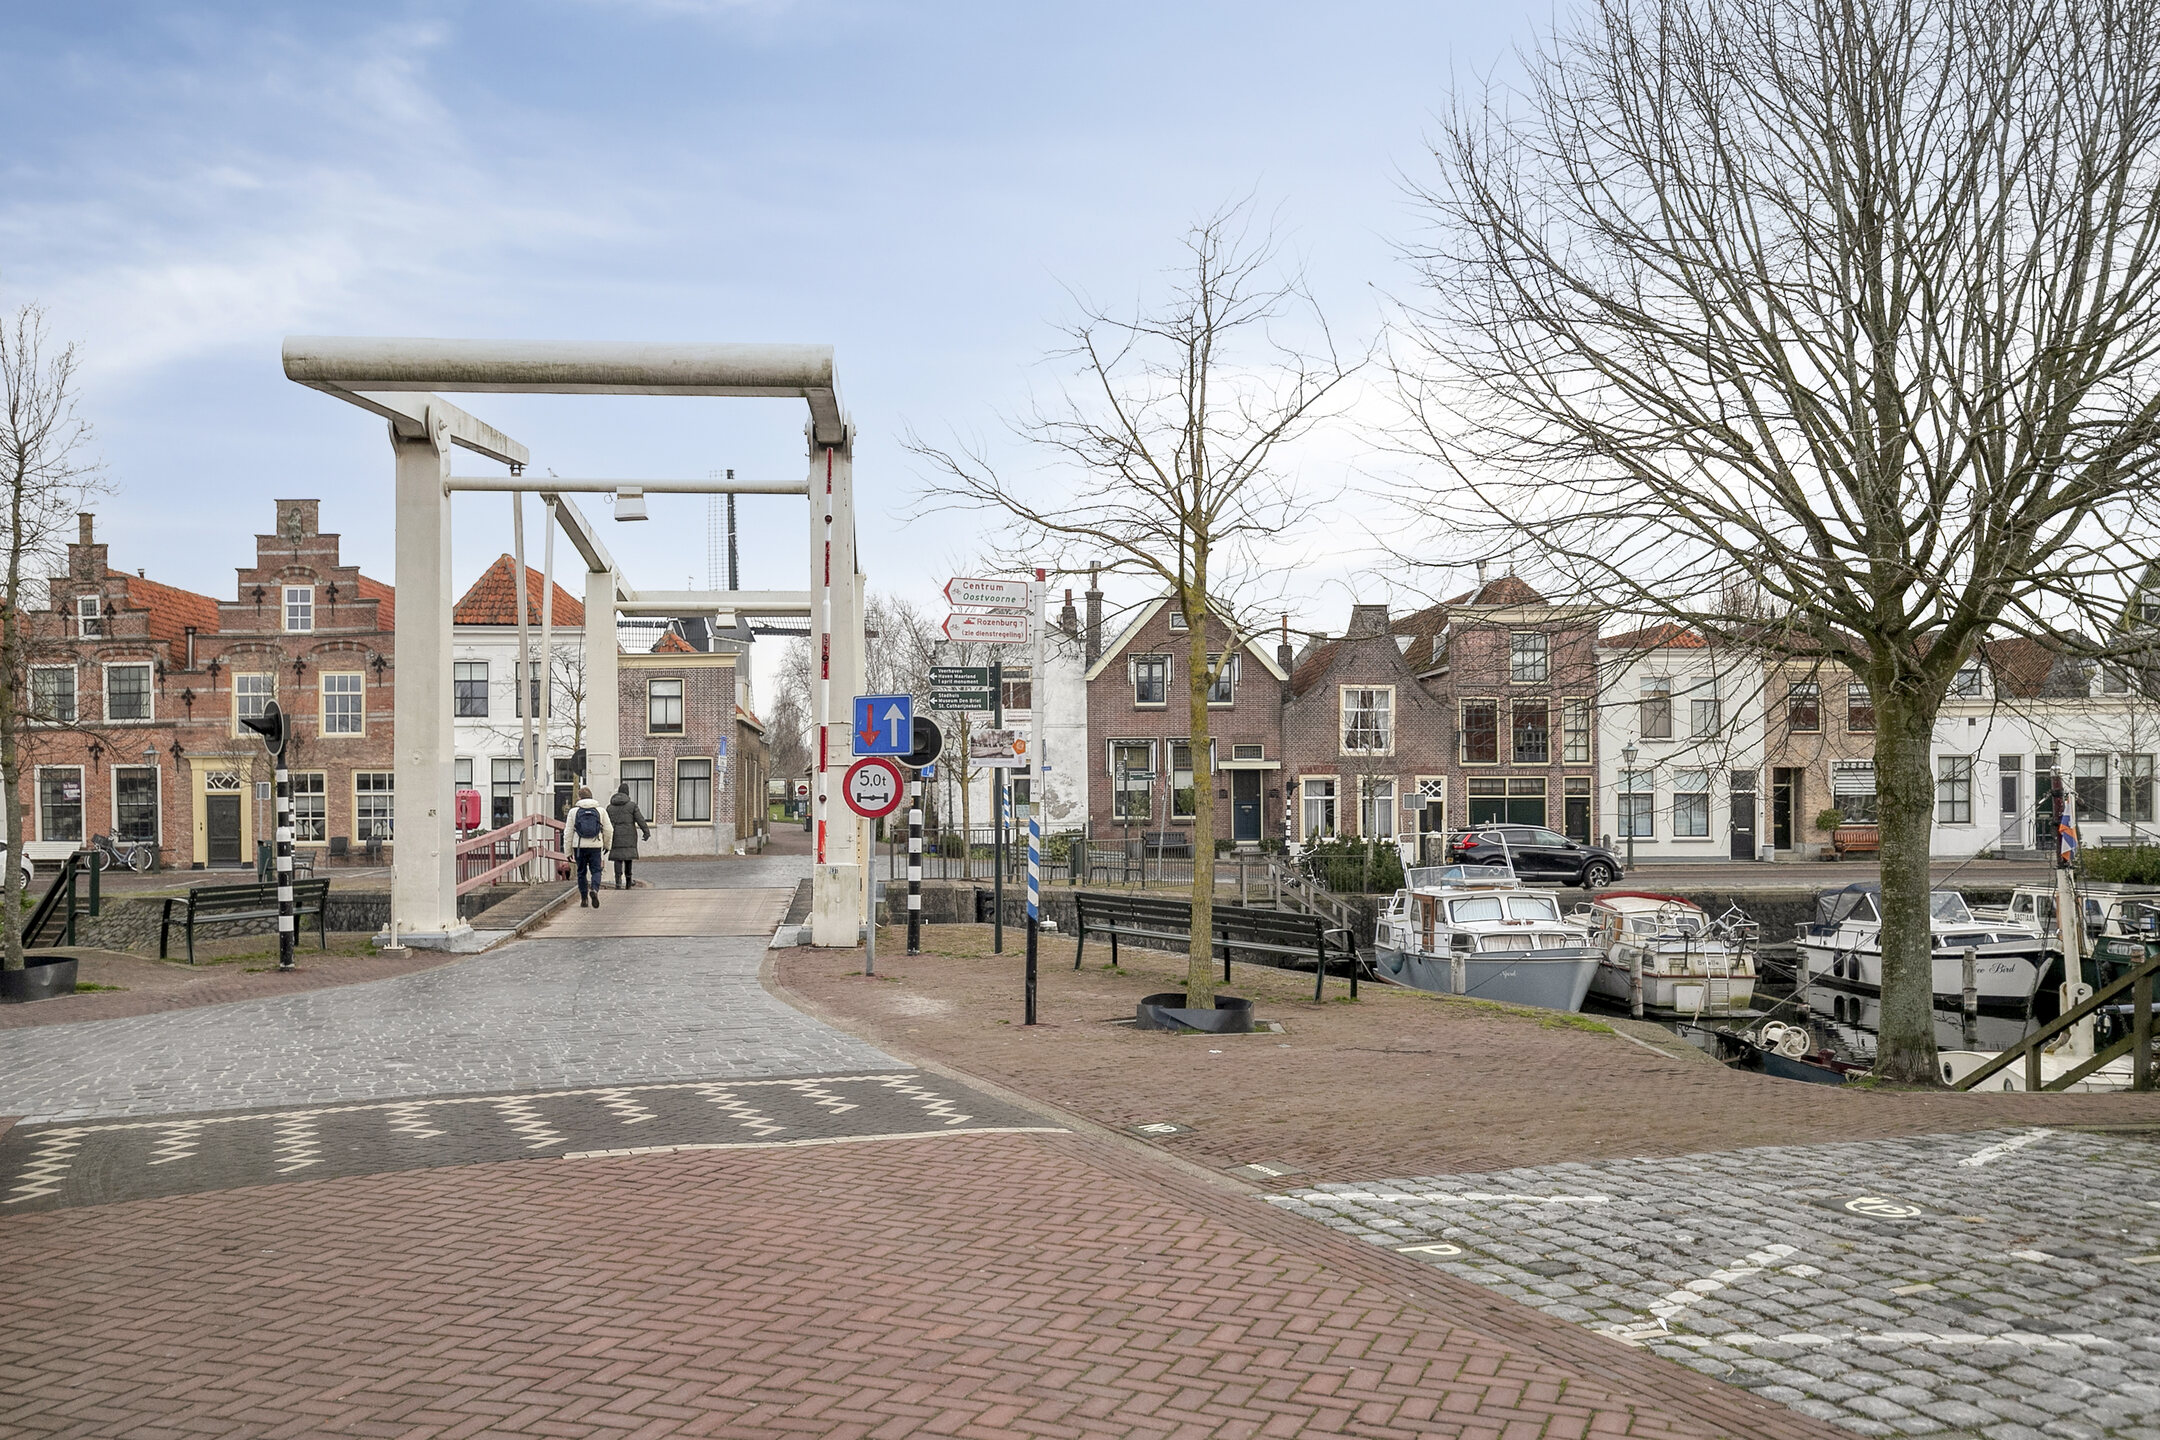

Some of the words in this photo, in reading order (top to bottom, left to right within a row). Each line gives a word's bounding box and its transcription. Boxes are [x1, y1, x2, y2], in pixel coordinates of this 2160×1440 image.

[962, 581, 1004, 591] Centrum
[962, 592, 1017, 603] Oostvoorne
[976, 618, 1018, 628] Rozenburg
[961, 629, 974, 637] (zie
[975, 630, 1024, 639] dienstregeling)
[2014, 912, 2036, 922] BASTIAAN
[1696, 959, 1720, 967] Brelle
[1989, 962, 2016, 974] Bird
[1395, 1244, 1462, 1256] P
